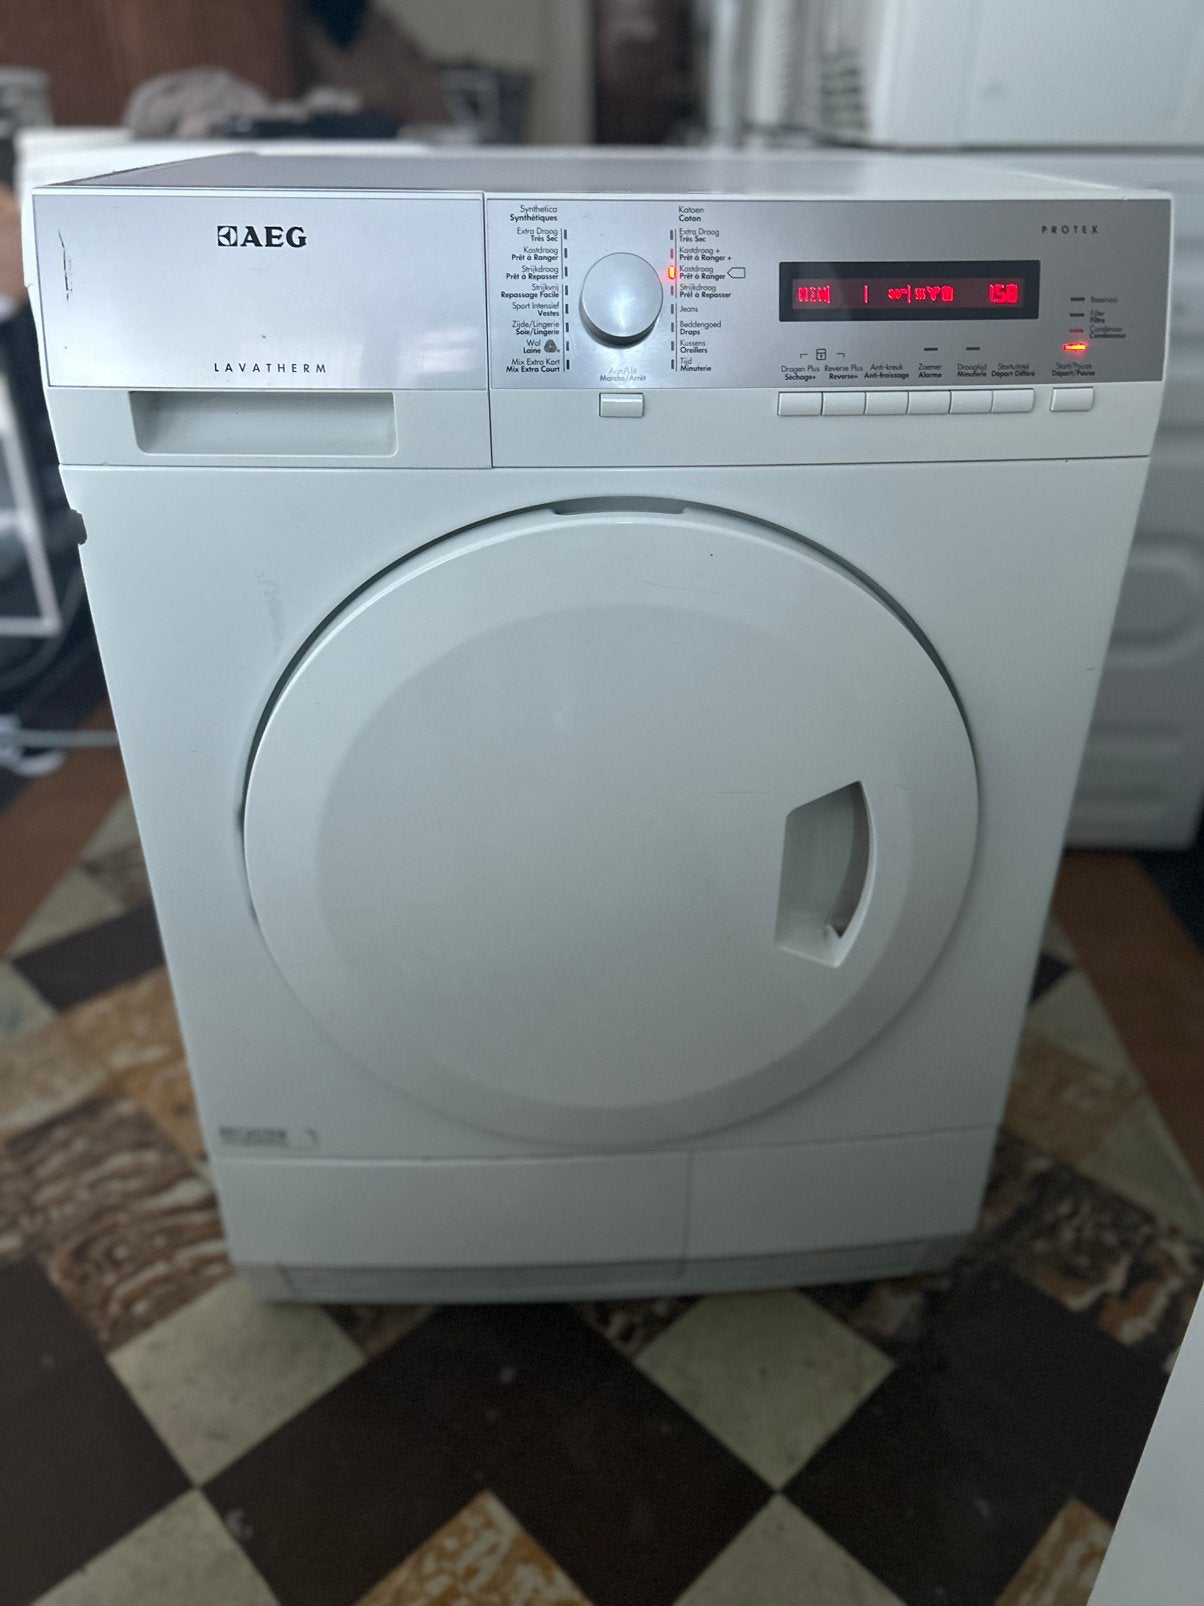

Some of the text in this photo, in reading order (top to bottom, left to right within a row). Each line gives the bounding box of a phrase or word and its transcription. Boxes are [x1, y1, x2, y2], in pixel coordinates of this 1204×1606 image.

[520, 205, 558, 214] Synthetica
[679, 206, 704, 214] Katoen
[510, 213, 558, 223] Synthétiques
[679, 214, 702, 222] Coton
[517, 227, 558, 236] Extra Droog
[680, 227, 720, 237] Extra Droog
[1041, 225, 1099, 234] PROTEX
[240, 226, 307, 248] AEG
[524, 246, 559, 255] Kastdroog
[680, 246, 714, 255] Kastdroog
[534, 254, 559, 262] Ranger
[701, 254, 726, 262] Ranger
[521, 265, 559, 274] Strijkdroog
[680, 265, 714, 274] Kastdroog
[528, 273, 559, 281] Repasser
[701, 273, 726, 281] Ranger
[532, 283, 560, 293] Strijkvrij
[680, 283, 717, 292] Strijkdroog
[501, 291, 538, 299] Repassage
[701, 291, 732, 299] Repasser
[512, 301, 559, 310] Sport Intensief
[680, 305, 699, 313] Jeans
[512, 320, 559, 329] Zijde/Lingerie
[680, 320, 722, 329] Beddengoed
[515, 328, 560, 336] Soie/Lingerie
[526, 339, 541, 347] Wol
[511, 358, 560, 366] Mix Extra Kort
[680, 358, 692, 366] Tijd
[919, 362, 943, 370] Zoemer
[214, 362, 326, 373] LAVATHERM
[540, 365, 560, 373] Court
[807, 364, 820, 372] Plus
[825, 363, 863, 372] Reverse Plus
[870, 363, 903, 371] Anti-kreuk
[864, 371, 910, 380] Anti-froissage
